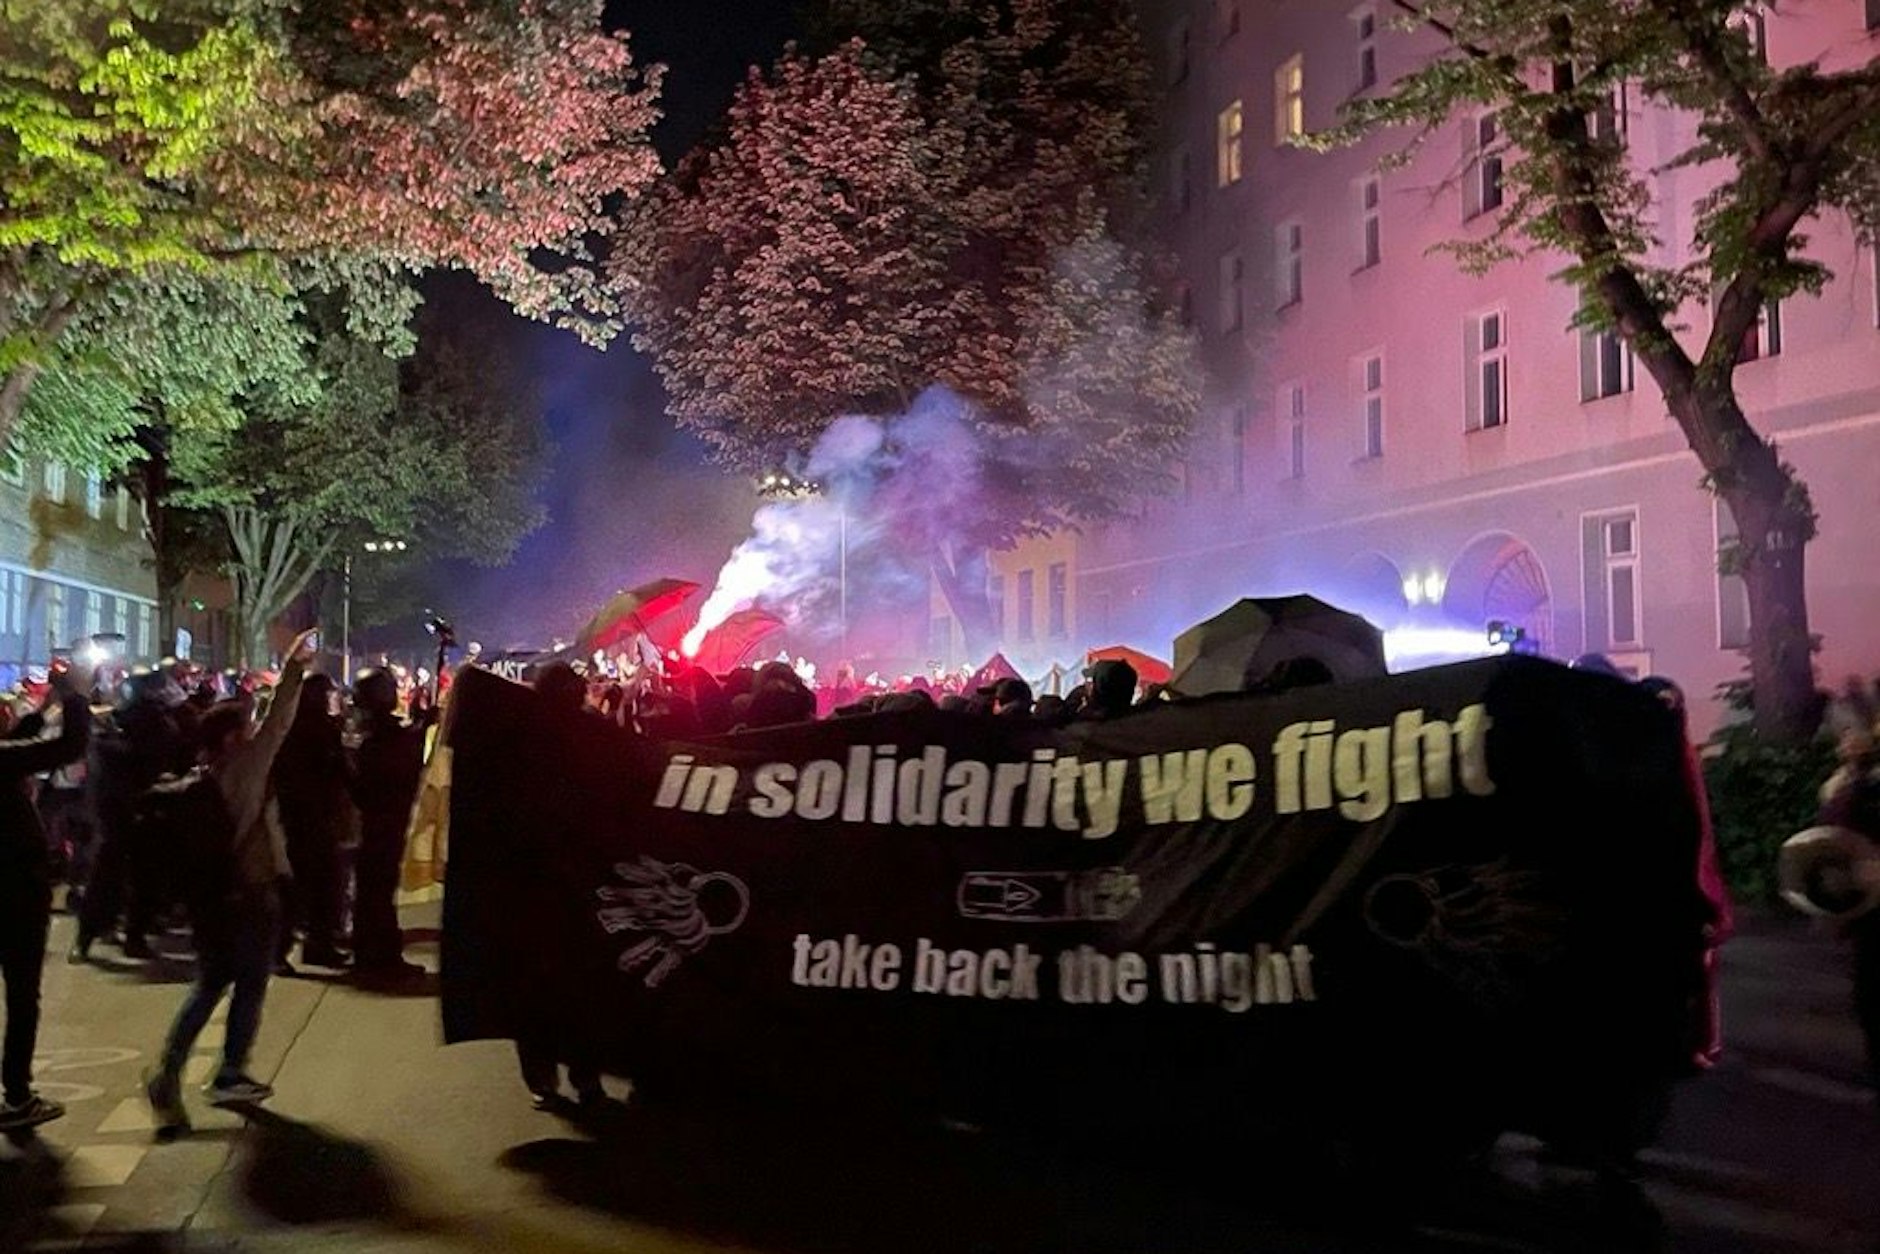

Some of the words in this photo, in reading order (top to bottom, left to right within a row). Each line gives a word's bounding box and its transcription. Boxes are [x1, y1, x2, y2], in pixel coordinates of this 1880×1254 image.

[654, 755, 738, 815] in
[749, 744, 1126, 838] solidarity
[1140, 743, 1256, 824] we
[1272, 703, 1496, 821] fight
[792, 934, 901, 989] take
[913, 938, 1043, 999] back
[1057, 944, 1148, 1004] the
[1160, 942, 1318, 1013] night
